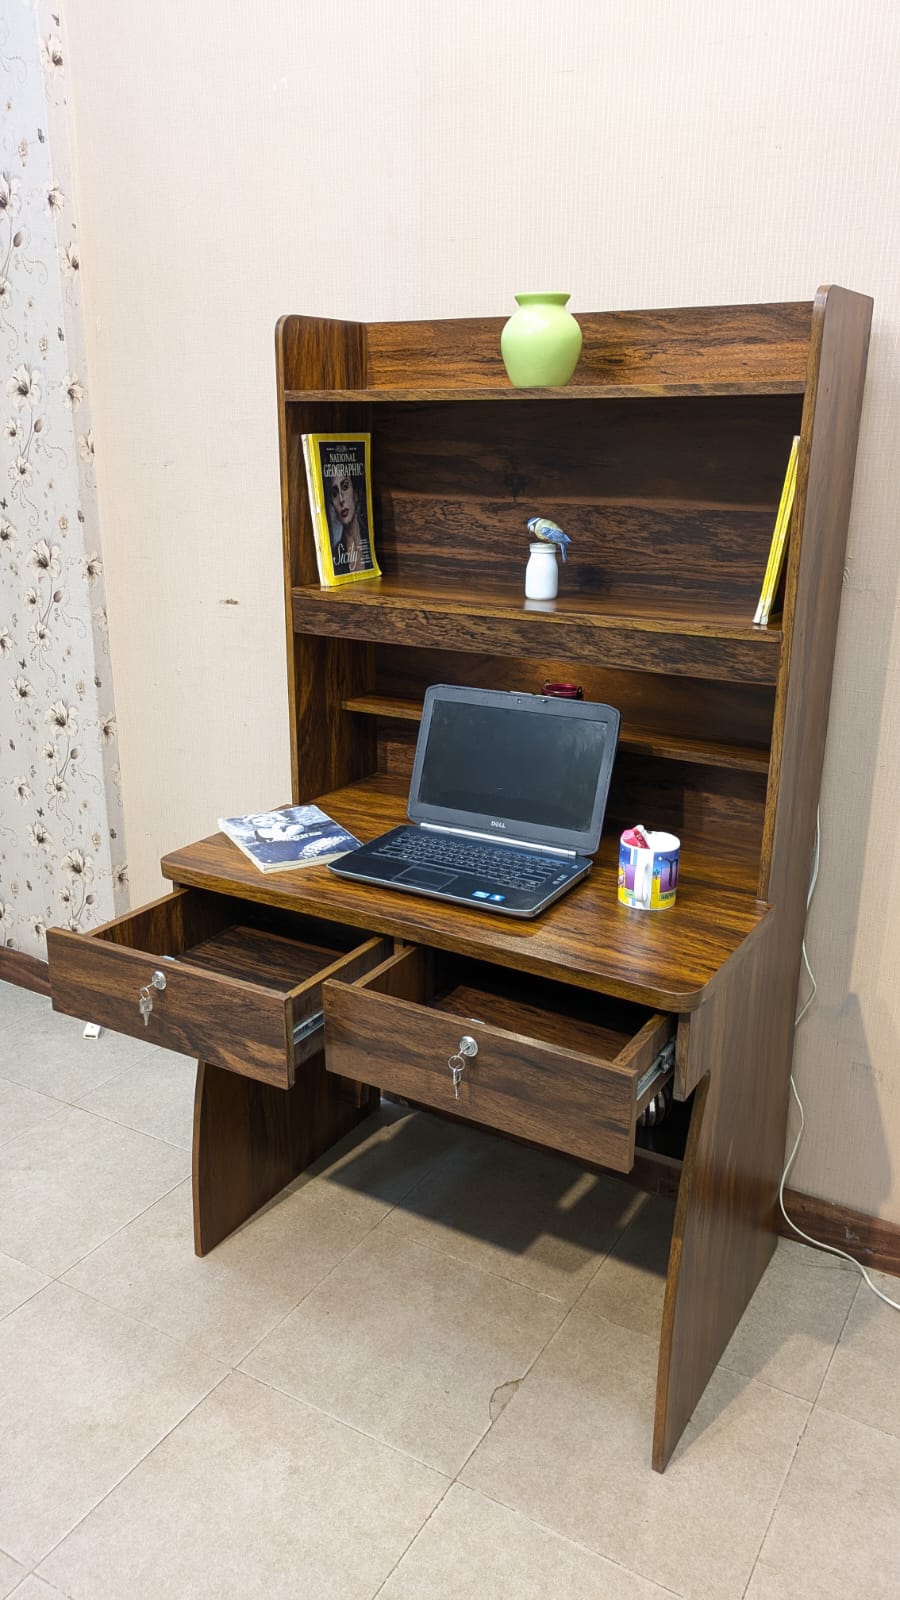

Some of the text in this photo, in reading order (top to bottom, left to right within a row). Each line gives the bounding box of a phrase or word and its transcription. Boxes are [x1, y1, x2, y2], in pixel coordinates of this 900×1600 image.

[329, 452, 356, 463] NATIONAL
[323, 463, 364, 478] GEOGRAPHIC
[333, 541, 358, 571] Sicily
[490, 820, 506, 829] DELL
